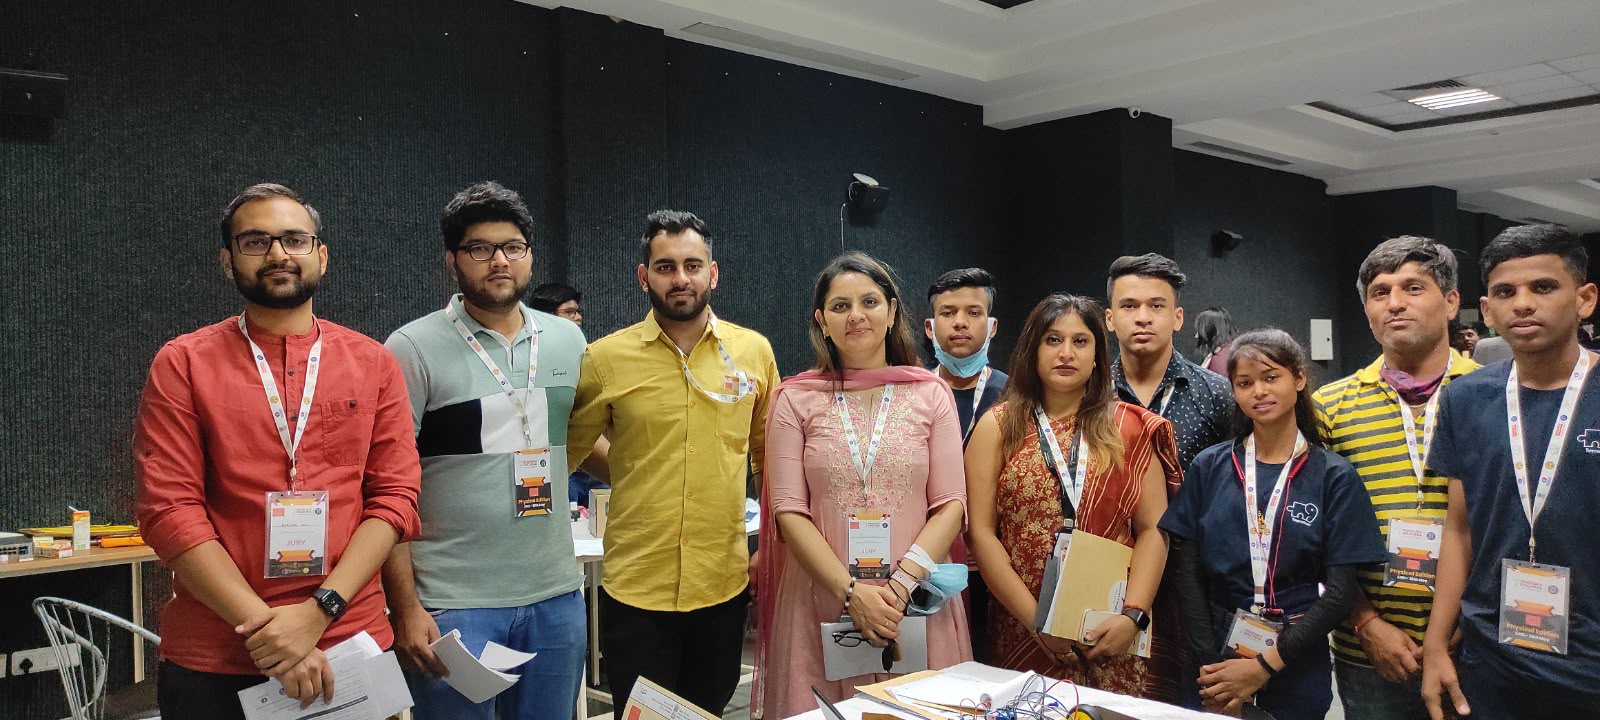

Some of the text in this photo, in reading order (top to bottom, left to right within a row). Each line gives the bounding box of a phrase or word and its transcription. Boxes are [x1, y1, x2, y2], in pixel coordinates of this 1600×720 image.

[286, 539, 306, 547] JURY
[1389, 568, 1436, 579] Physical Edition
[1506, 622, 1560, 639] Physical Edition
